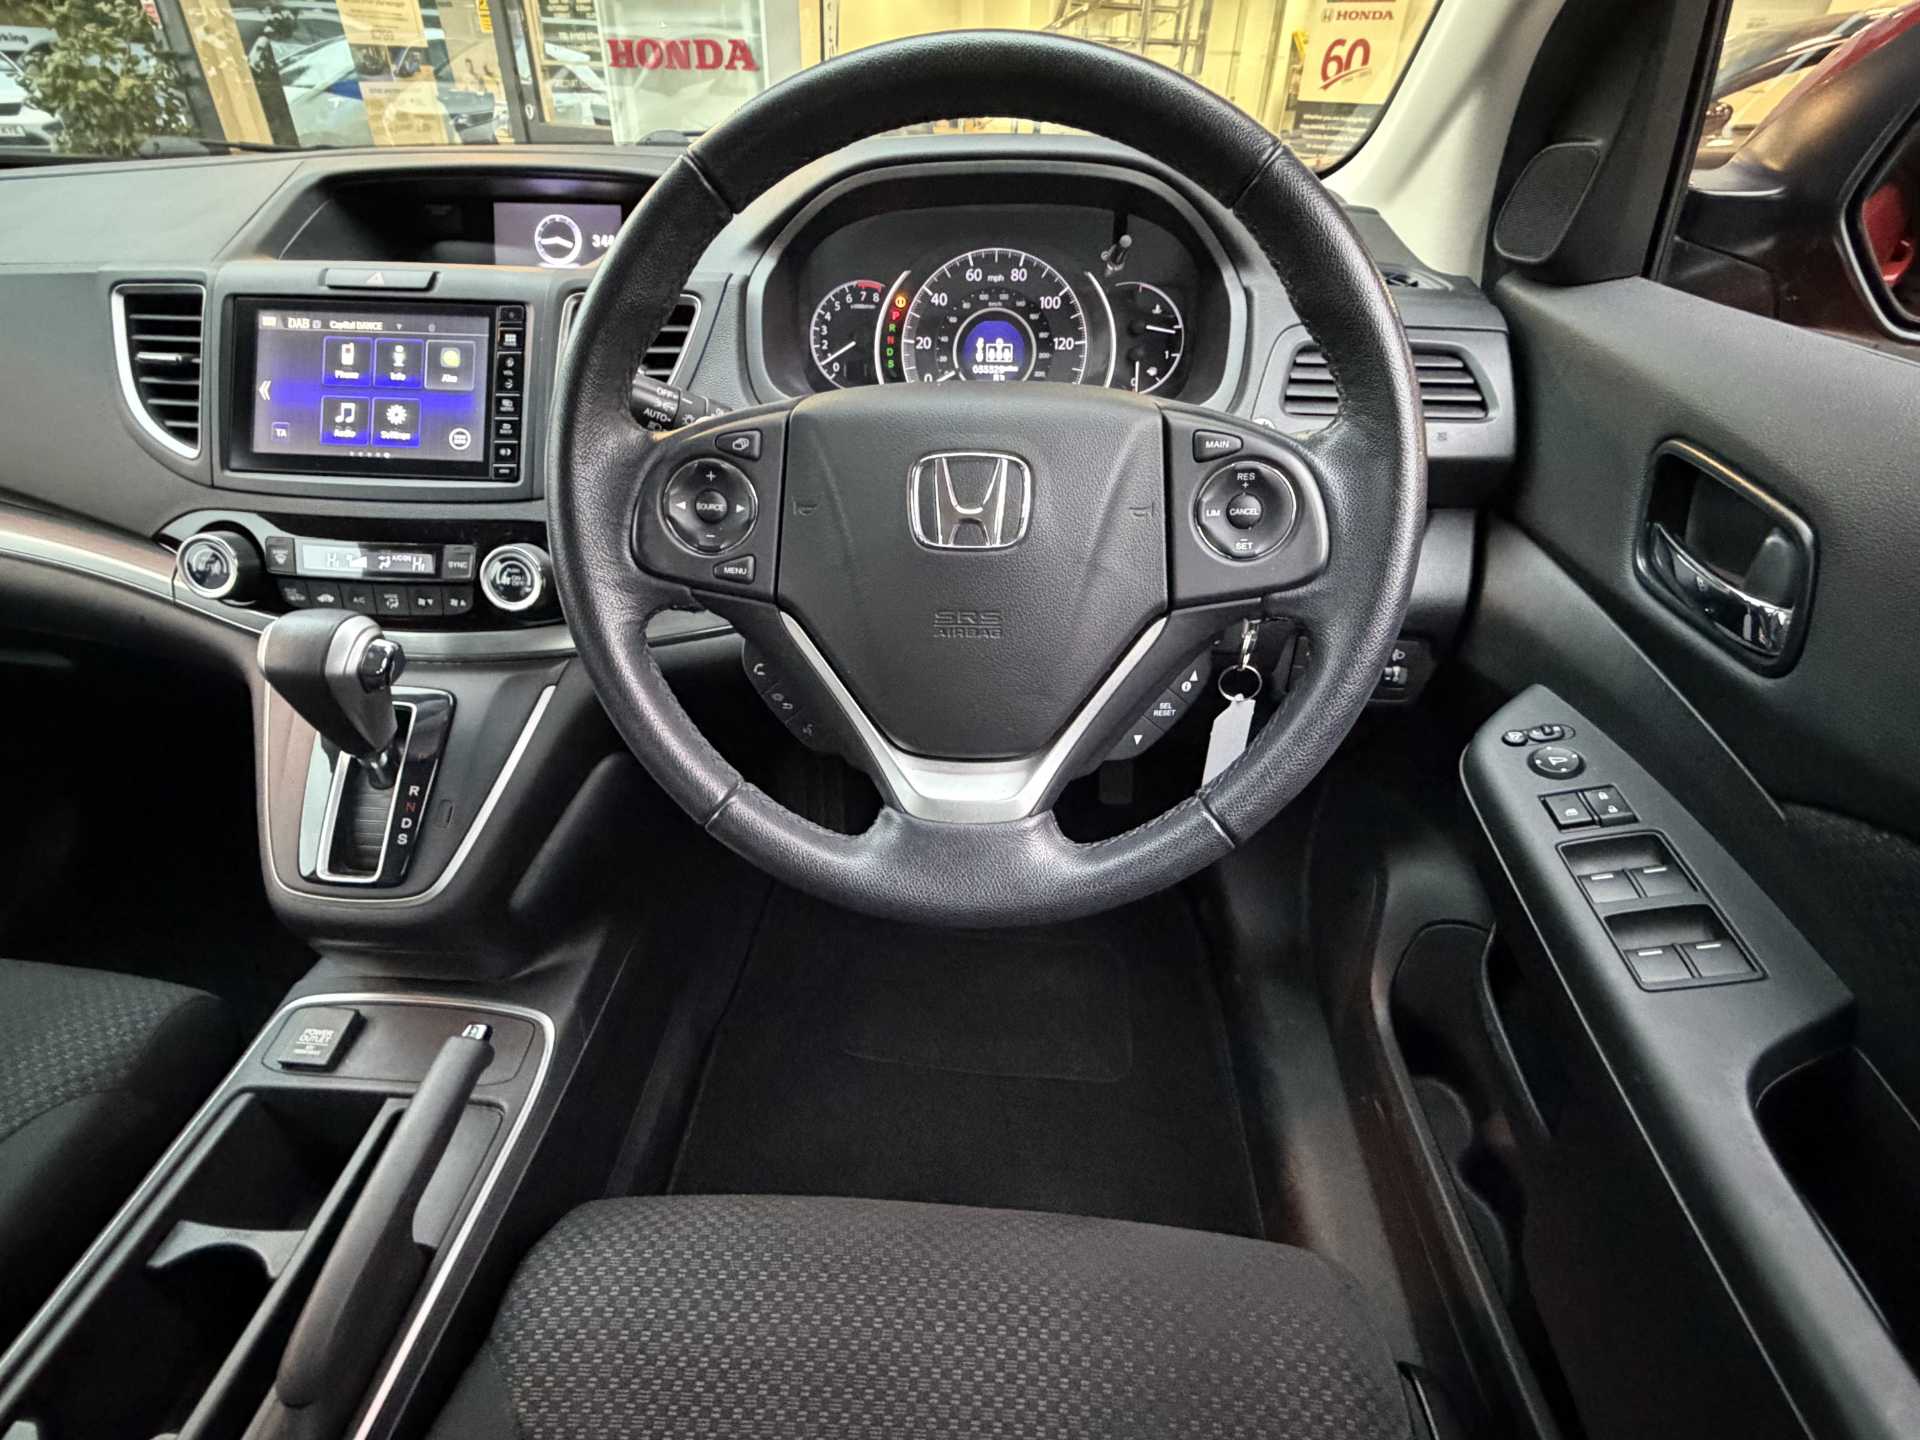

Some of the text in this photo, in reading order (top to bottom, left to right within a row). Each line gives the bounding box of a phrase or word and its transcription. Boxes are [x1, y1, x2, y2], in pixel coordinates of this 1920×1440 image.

[1336, 10, 1394, 21] HONDA
[607, 38, 760, 73] HONDA
[1321, 38, 1371, 83] 60
[965, 268, 982, 282] 60
[987, 274, 1005, 283] mph
[1010, 268, 1027, 282] 80
[846, 293, 853, 303] 6
[860, 291, 867, 301] 7
[872, 293, 880, 303] 8
[930, 292, 948, 306] 40
[834, 301, 841, 311] 5
[1040, 295, 1061, 309] 100
[824, 311, 831, 321] 4
[892, 311, 900, 320] P
[287, 317, 310, 329] DAB
[888, 323, 896, 333] R
[821, 325, 828, 335] 3
[821, 340, 828, 350] 2
[915, 336, 932, 350] 20
[1053, 337, 1074, 350] 120
[886, 347, 894, 357] D
[833, 362, 840, 372] 0
[656, 387, 674, 399] OFF
[643, 407, 668, 422] AUTO
[275, 428, 288, 438] TA
[1205, 440, 1230, 449] MAIN
[1237, 472, 1255, 481] RES
[696, 503, 725, 511] SOURCE
[1229, 508, 1259, 516] CANCEL
[1206, 509, 1221, 517] LIM
[1236, 542, 1254, 550] SET
[448, 561, 468, 569] SYNC
[724, 566, 748, 576] MENU
[933, 610, 1001, 625] SRS
[933, 627, 1001, 639] AIRBAG
[1159, 702, 1172, 710] SEL
[1153, 709, 1176, 717] RESET
[409, 785, 420, 797] R
[406, 802, 416, 812] N
[401, 818, 412, 829] D
[397, 833, 408, 845] S
[302, 1028, 335, 1037] POWER
[298, 1034, 330, 1043] OUTLET
